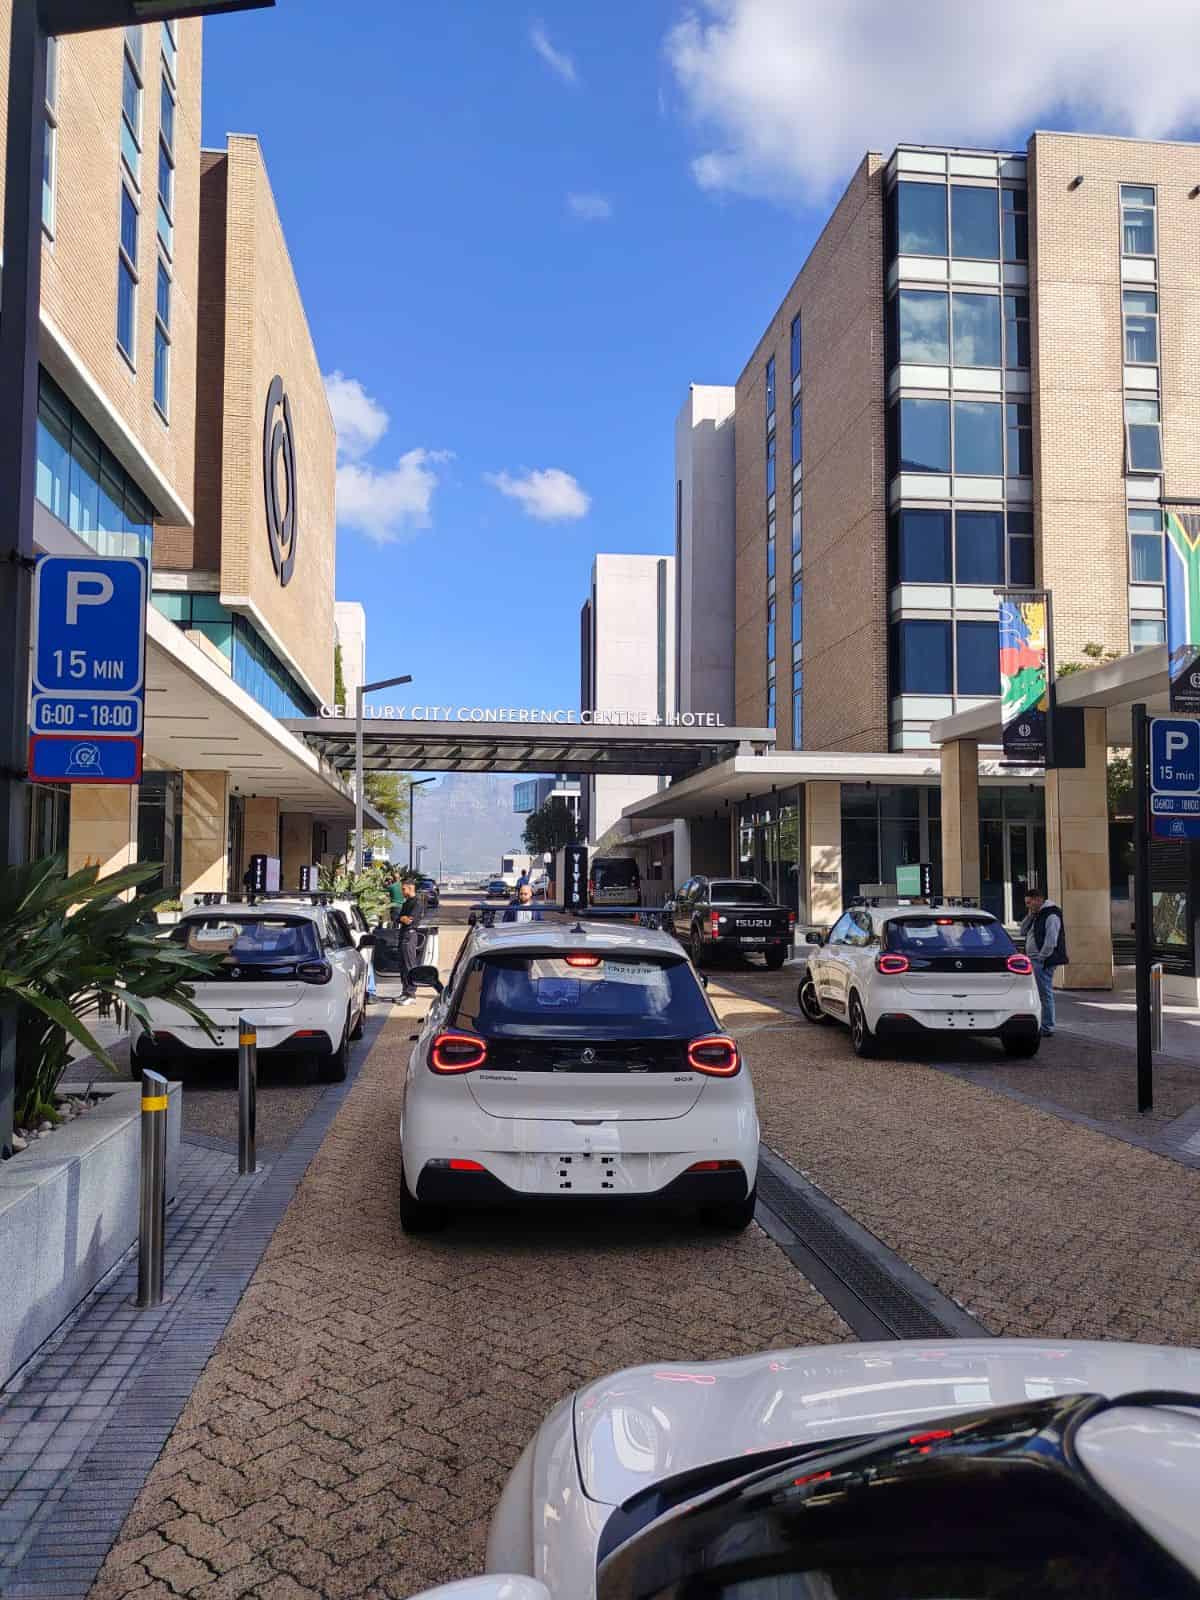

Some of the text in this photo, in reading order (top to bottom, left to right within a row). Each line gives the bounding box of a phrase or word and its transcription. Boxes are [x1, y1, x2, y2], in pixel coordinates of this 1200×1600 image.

[66, 571, 114, 625] P
[53, 651, 124, 680] 15 MIN
[41, 704, 74, 725] 6:00
[91, 705, 132, 726] 18:00
[411, 705, 452, 721] CITY
[457, 707, 576, 724] CONFERENCE
[669, 711, 726, 727] HOTEL
[1165, 731, 1189, 761] P
[1160, 766, 1195, 781] 15 min
[736, 919, 772, 928] ISUZU
